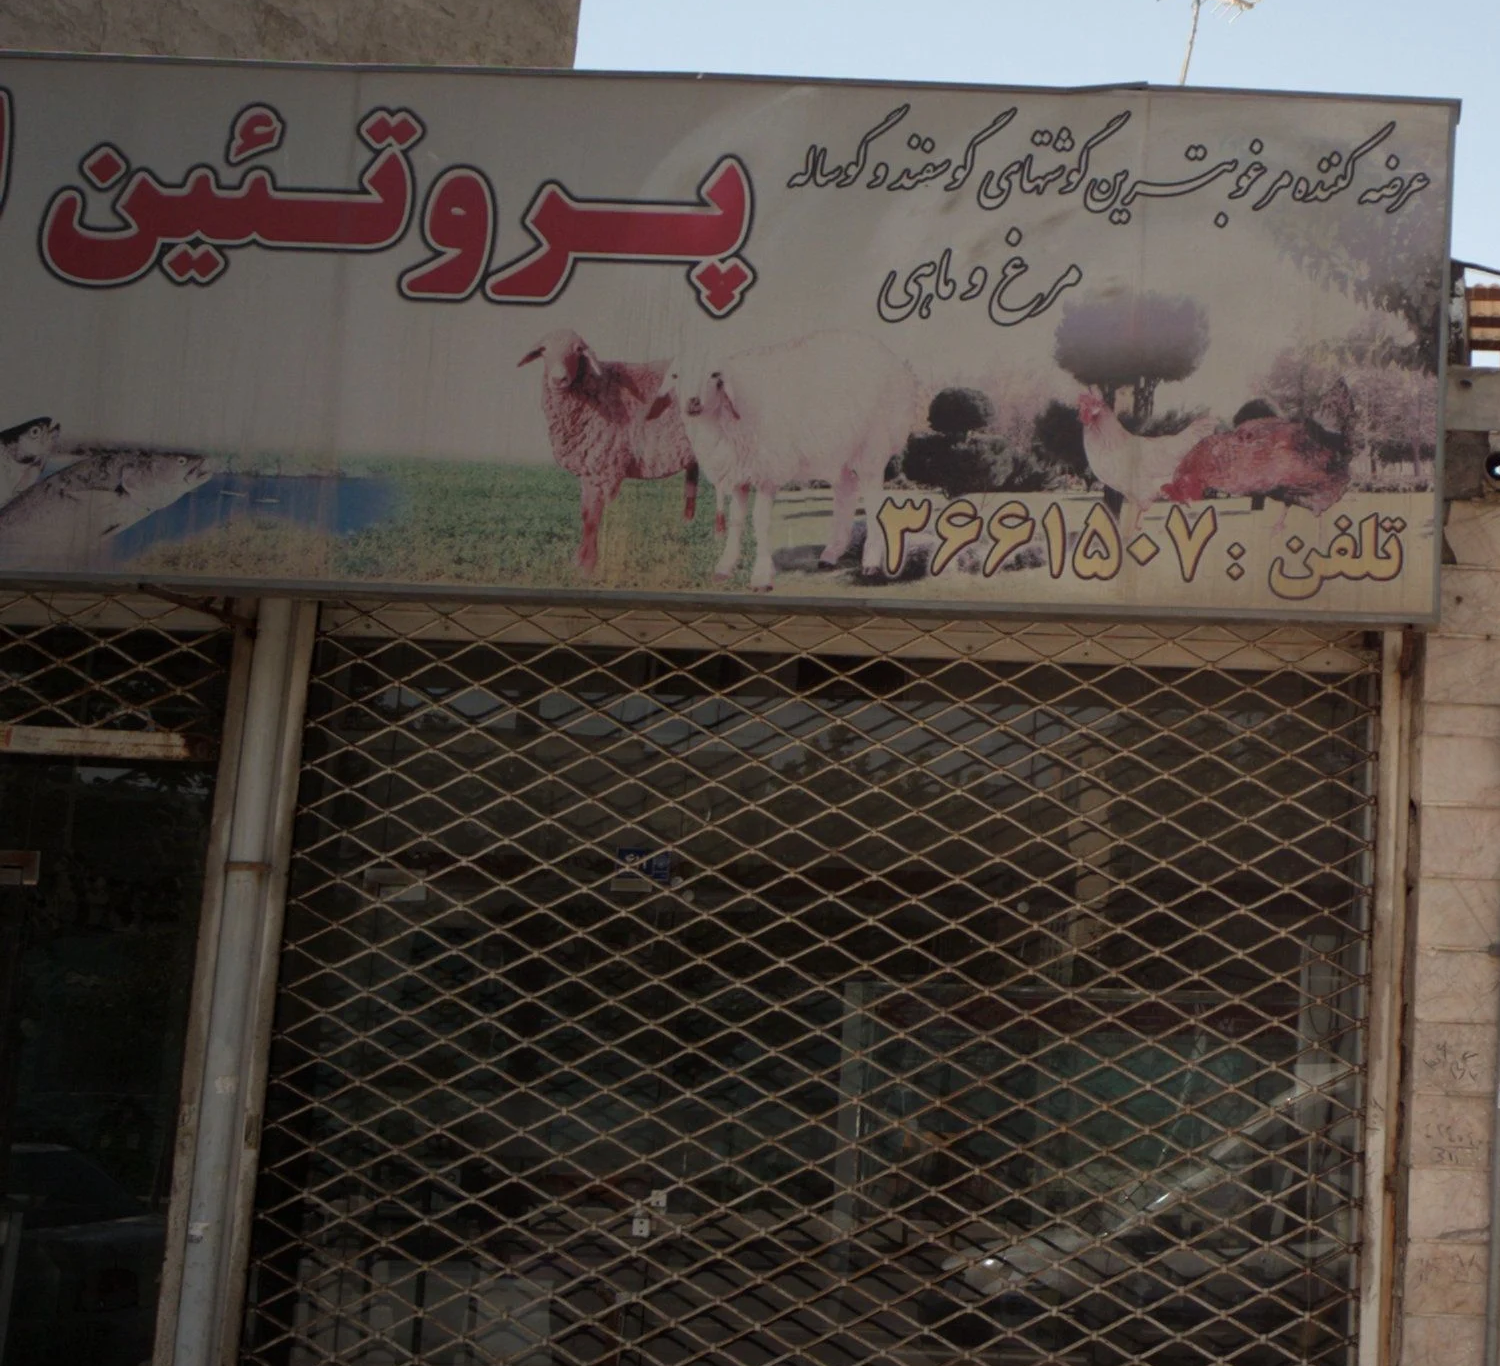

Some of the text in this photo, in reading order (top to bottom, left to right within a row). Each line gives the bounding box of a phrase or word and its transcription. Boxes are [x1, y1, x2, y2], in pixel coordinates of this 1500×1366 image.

[786, 103, 911, 189] گوساله
[866, 162, 890, 190] و
[887, 106, 1018, 192] گوسفند
[1292, 120, 1396, 203] کننده
[1357, 154, 1431, 213] عرضه
[38, 102, 757, 318] پروتئین
[876, 226, 1083, 327] مرغ و ماهی
[876, 496, 1219, 583] ۳۶۶۱۵۰۷
